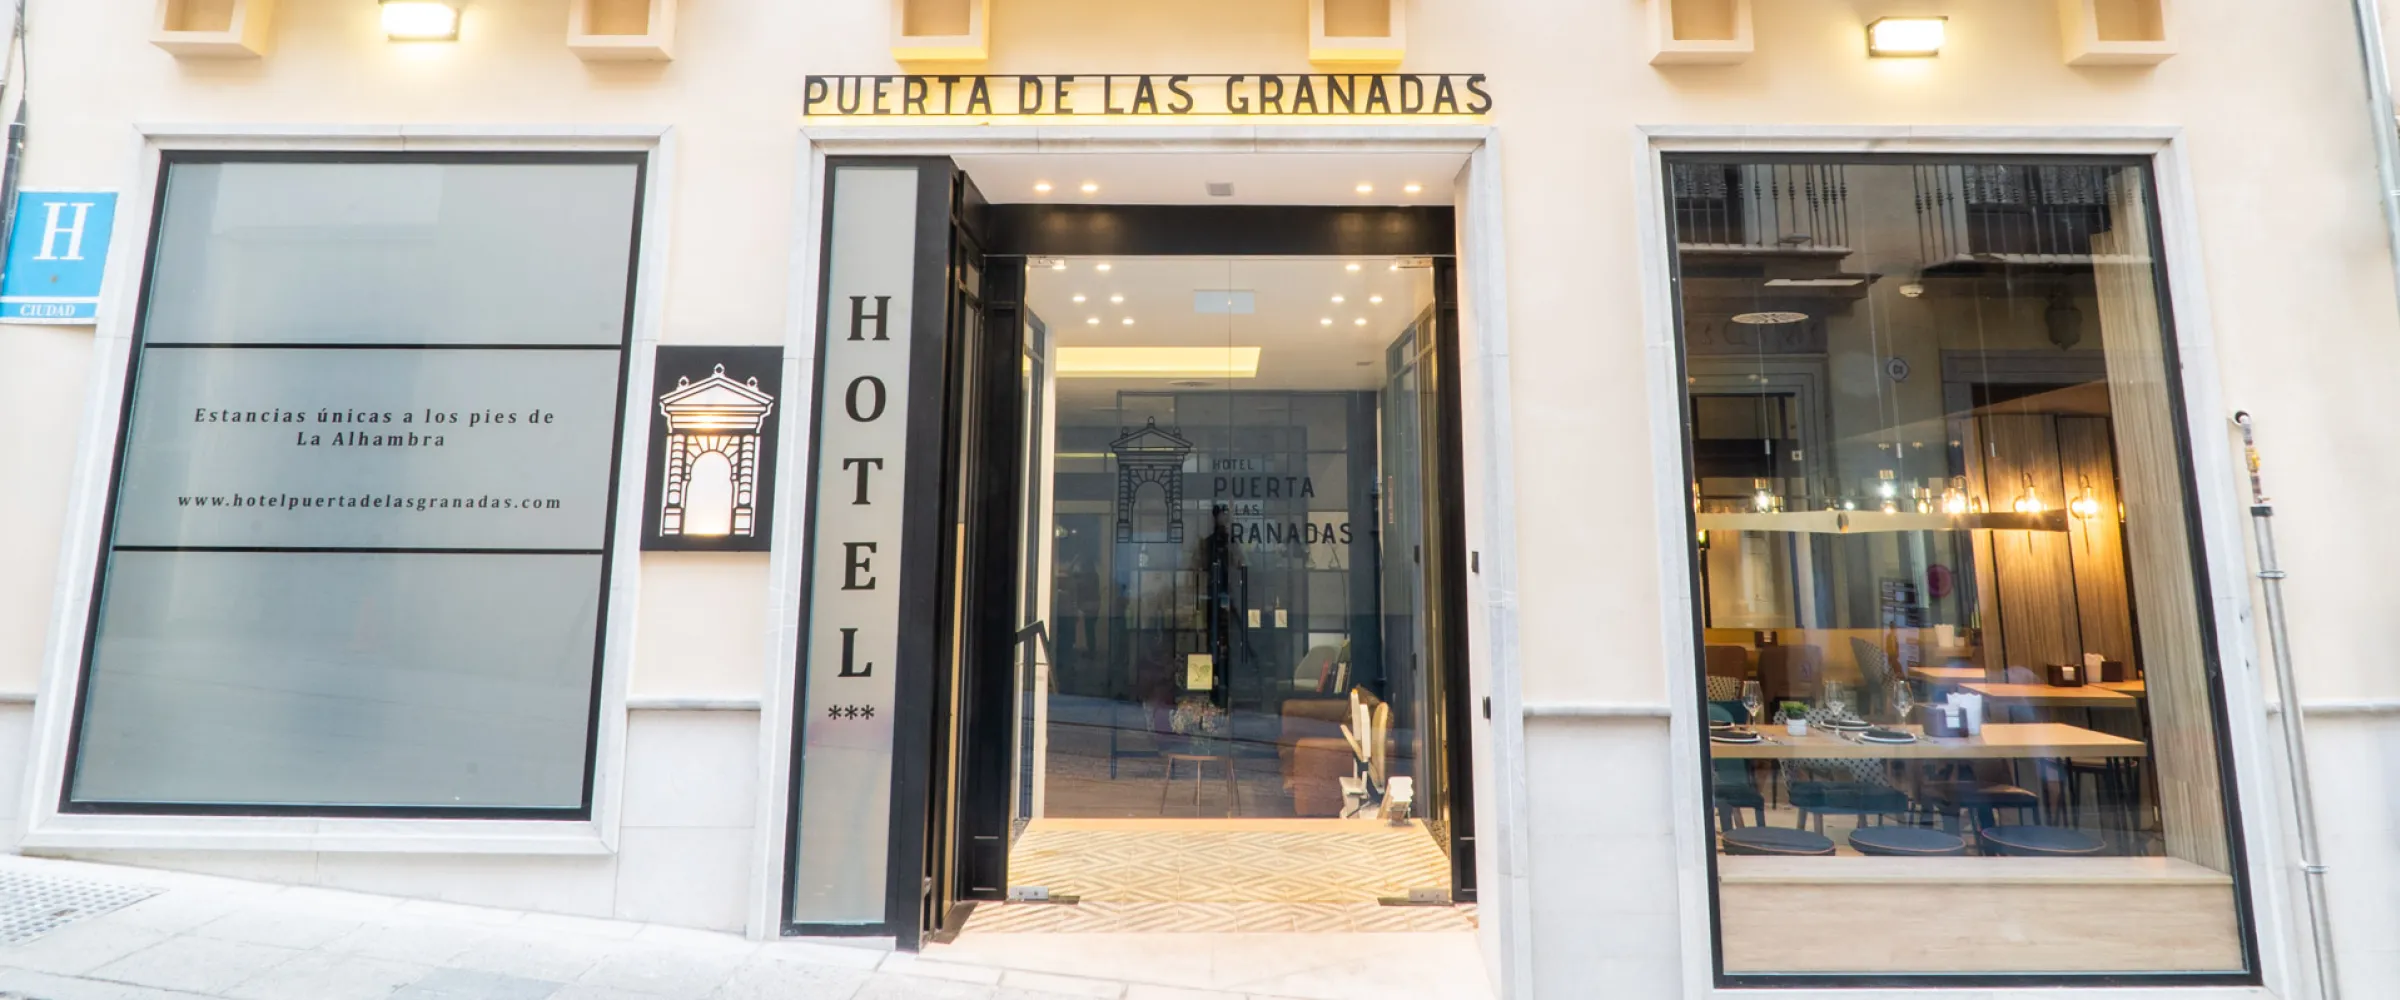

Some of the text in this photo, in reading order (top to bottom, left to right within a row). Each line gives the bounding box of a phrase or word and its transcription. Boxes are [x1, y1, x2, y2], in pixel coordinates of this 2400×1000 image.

[803, 74, 1493, 115] PUERTA DE LAS GRANADAS
[32, 202, 96, 260] H
[20, 303, 76, 317] CIUDAD
[194, 408, 555, 428] Estancias únicas a los pies de
[296, 431, 445, 447] La Alhambra
[1212, 459, 1254, 471] HOTEL
[837, 296, 892, 678] HOTEL
[1213, 477, 1315, 498] PUERTA
[177, 493, 561, 512] www.hotelpuertadelasgranadas.com
[1235, 504, 1260, 516] LAS
[1213, 522, 1354, 545] RANADAS
